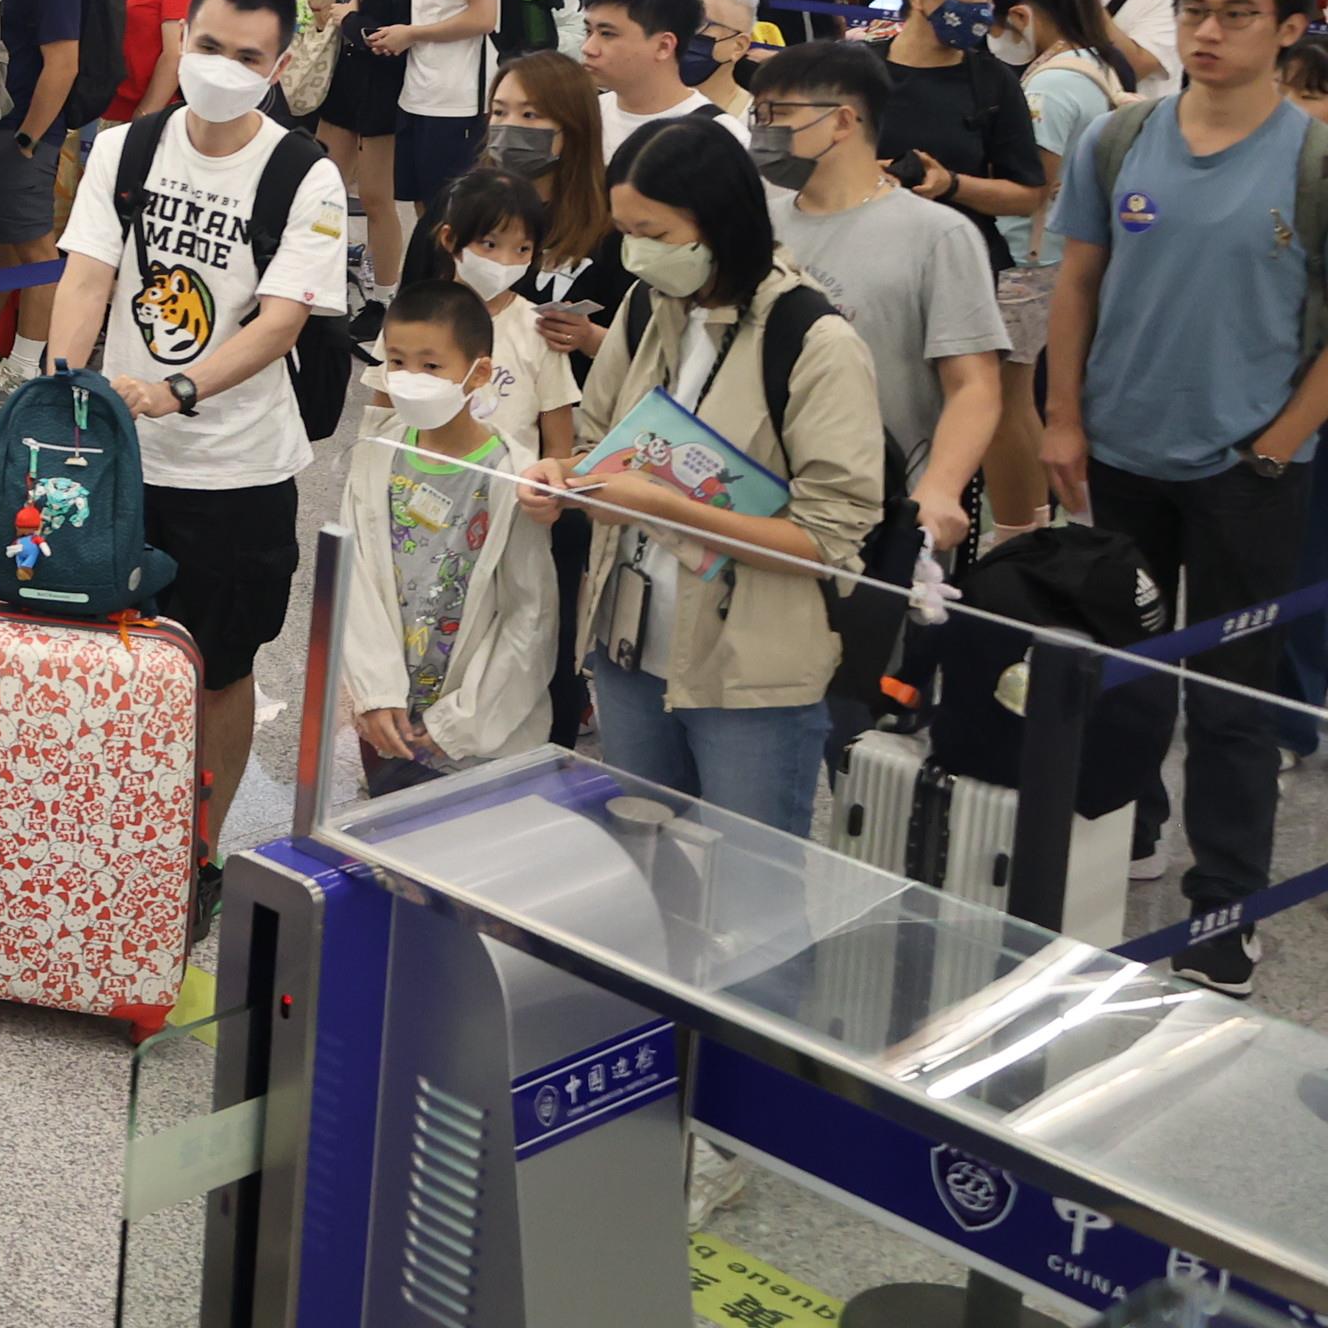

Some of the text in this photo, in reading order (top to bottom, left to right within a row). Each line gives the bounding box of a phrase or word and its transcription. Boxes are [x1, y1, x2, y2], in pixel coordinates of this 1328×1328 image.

[146, 221, 232, 270] MADE
[726, 1262, 837, 1321] queue
[1048, 1254, 1129, 1303] CHINA
